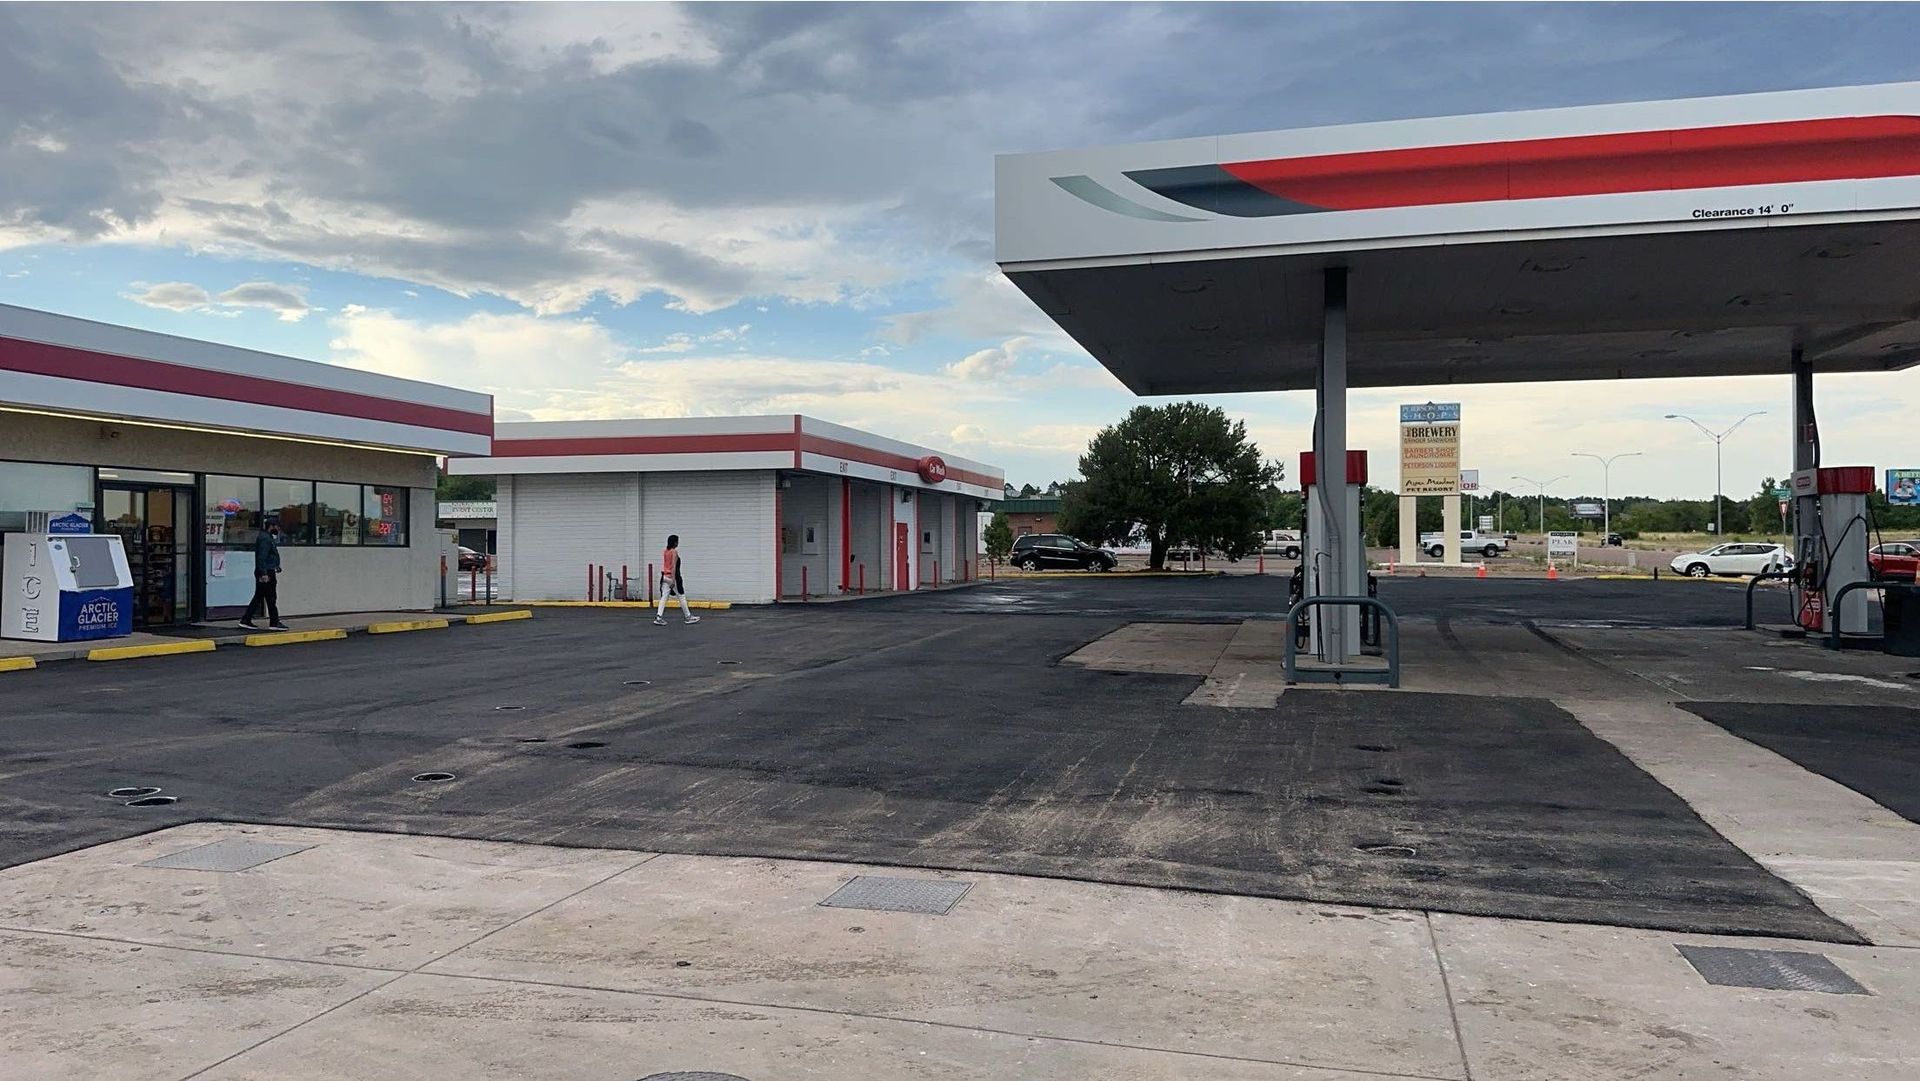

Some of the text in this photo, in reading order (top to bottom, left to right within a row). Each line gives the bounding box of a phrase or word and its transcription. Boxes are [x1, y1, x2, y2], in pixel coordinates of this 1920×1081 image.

[1692, 208, 1754, 218] Clearance
[1759, 204, 1773, 215] 14'
[1412, 427, 1456, 437] BREWERY
[840, 461, 848, 472] EXIT
[929, 463, 946, 476] Car Wash
[80, 601, 118, 614] ARCTIC
[77, 611, 119, 625] GLACIER
